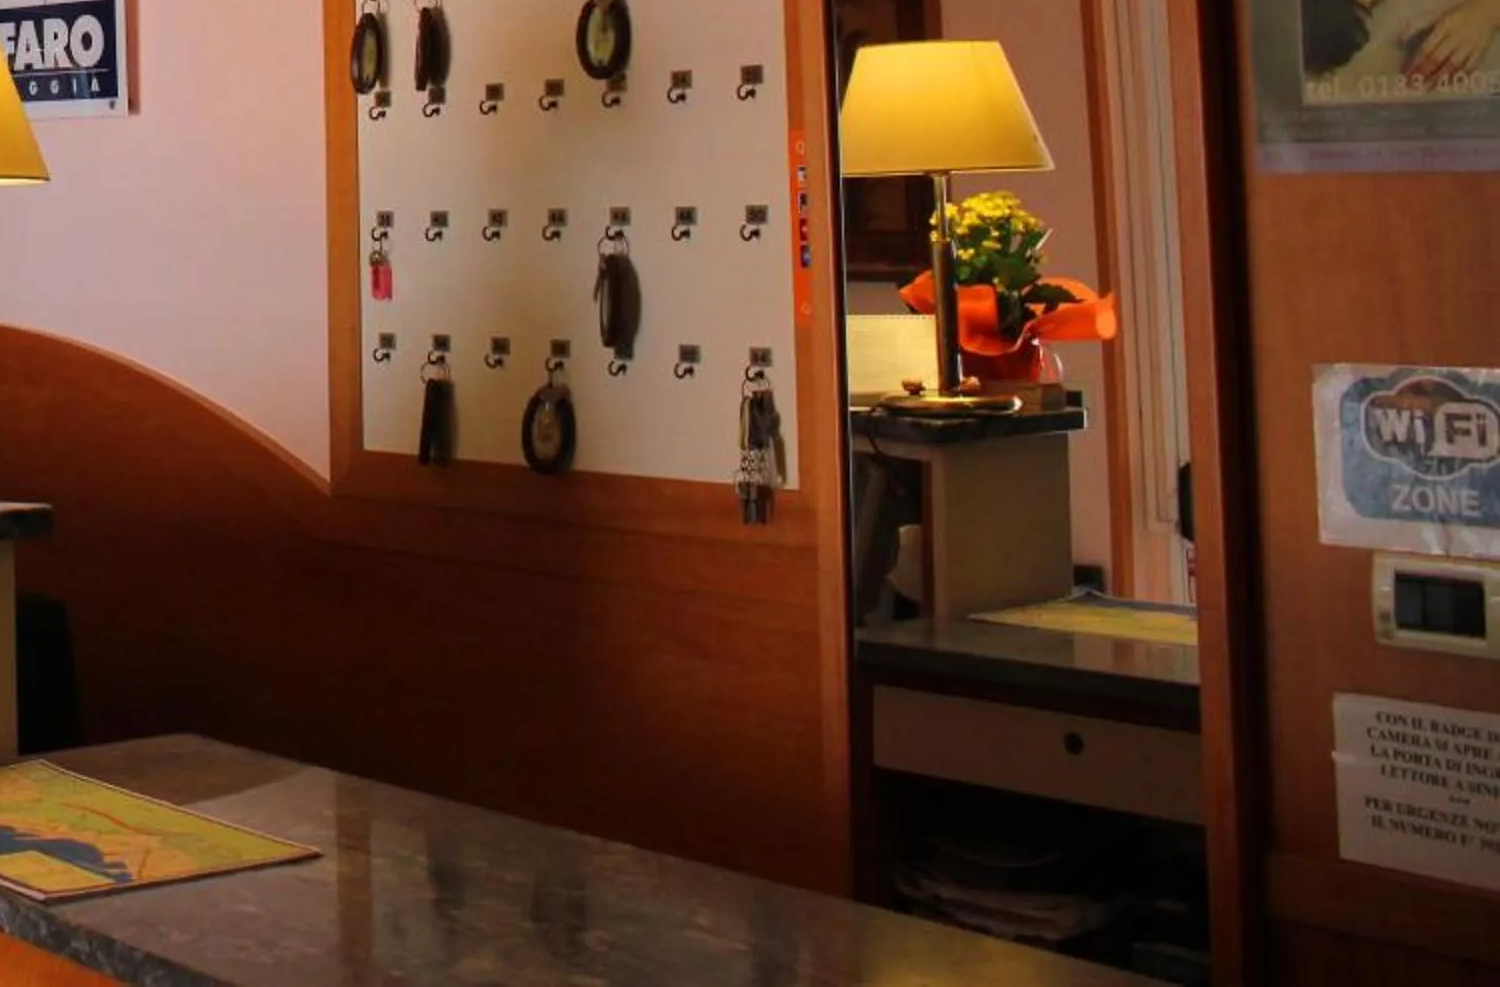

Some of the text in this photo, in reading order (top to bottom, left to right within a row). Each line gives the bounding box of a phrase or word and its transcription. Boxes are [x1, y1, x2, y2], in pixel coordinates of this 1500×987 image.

[27, 77, 101, 96] GGIA
[1391, 483, 1481, 516] ZONE
[1375, 711, 1408, 727] CON
[1411, 717, 1426, 730] IL
[1430, 719, 1481, 739] BADGE
[1366, 726, 1431, 748] CAMERA
[1453, 742, 1492, 760] APRE
[1370, 743, 1390, 759] LA
[1393, 747, 1442, 769] PORTA
[1445, 759, 1462, 773] DI
[1380, 763, 1449, 788] LETTORE
[1363, 795, 1393, 812] PER
[1396, 801, 1469, 827] URGENZE
[1370, 814, 1387, 829] IL
[1388, 818, 1457, 843] NUMERO
